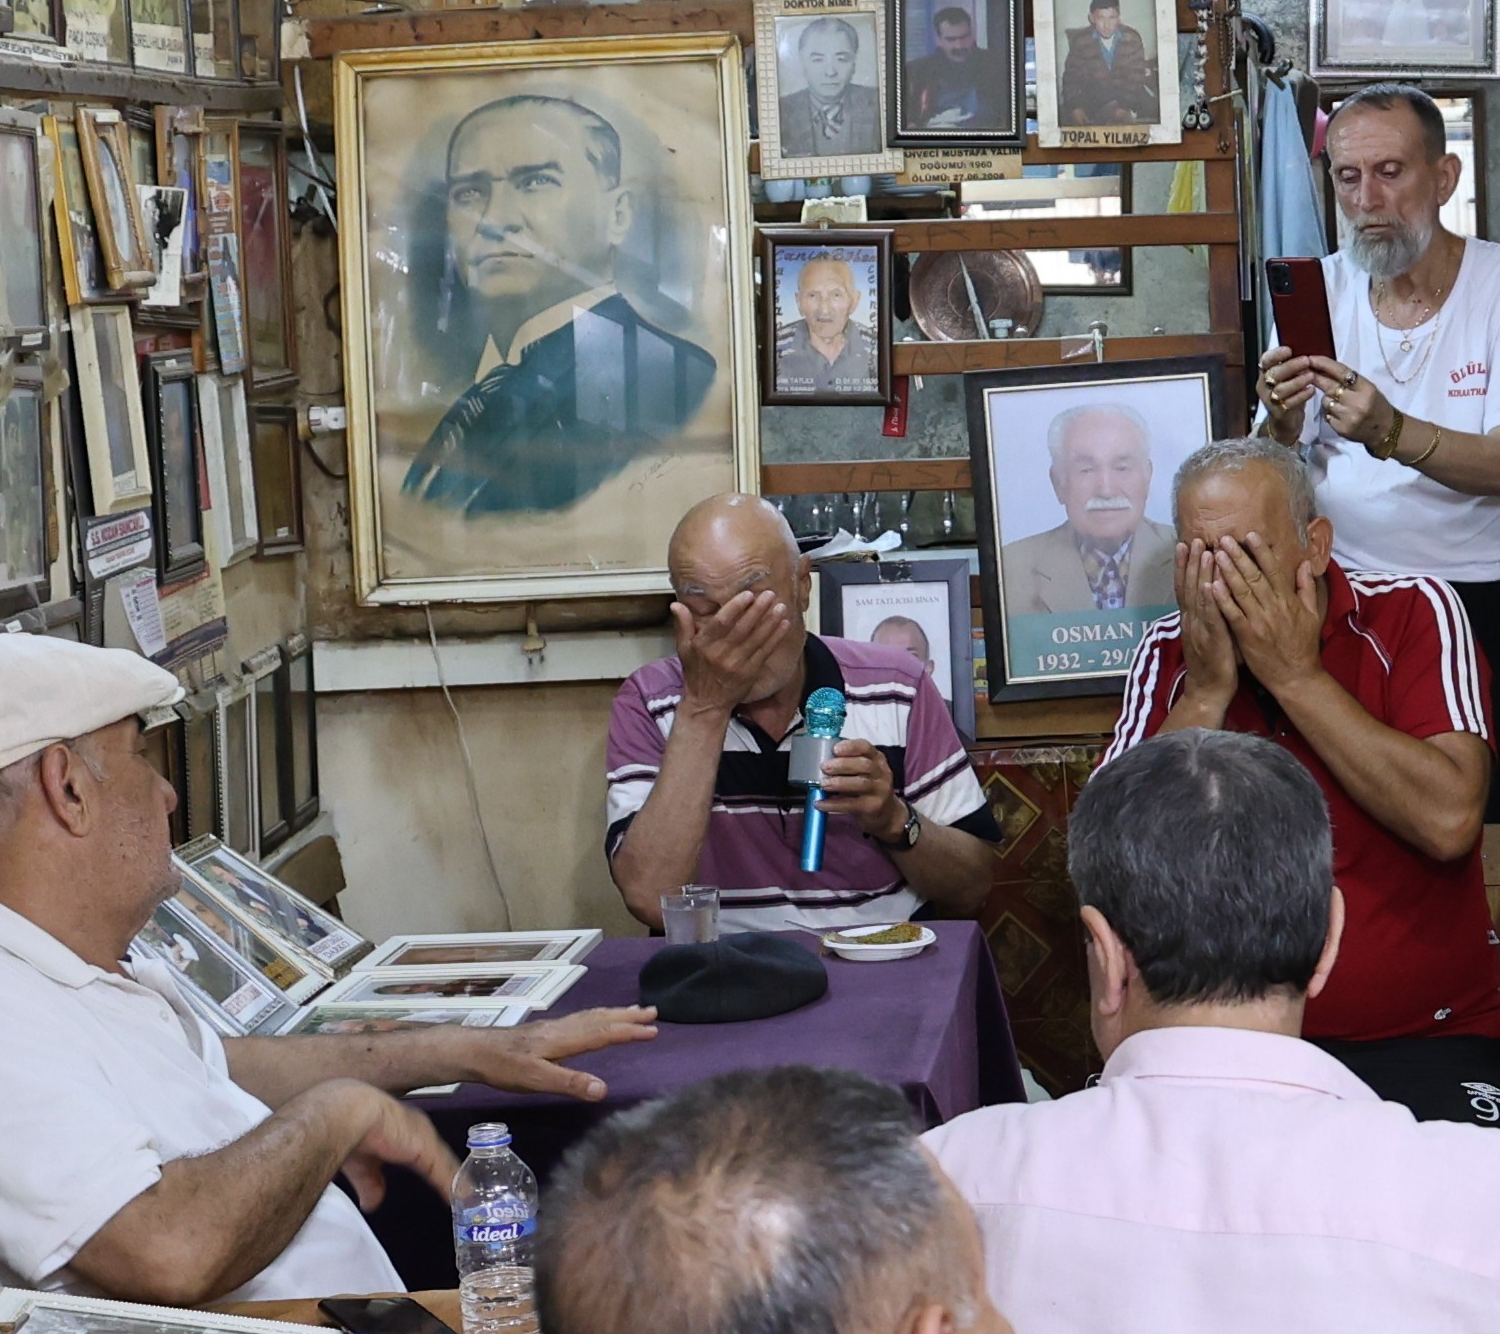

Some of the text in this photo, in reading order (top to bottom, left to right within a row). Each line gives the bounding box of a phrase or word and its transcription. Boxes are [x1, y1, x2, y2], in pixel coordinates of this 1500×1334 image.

[1061, 130, 1149, 146] TOPAL YILMAZ
[902, 147, 940, 160] AHVECİ
[942, 147, 988, 159] MUSTAFA
[919, 160, 993, 172] DOĞUMU: 1960
[1450, 361, 1486, 384] ÖLÜL
[855, 598, 875, 608] ŞAM
[1051, 621, 1134, 645] OSMAN
[1037, 652, 1081, 674] 1932
[472, 1223, 519, 1243] ideal
